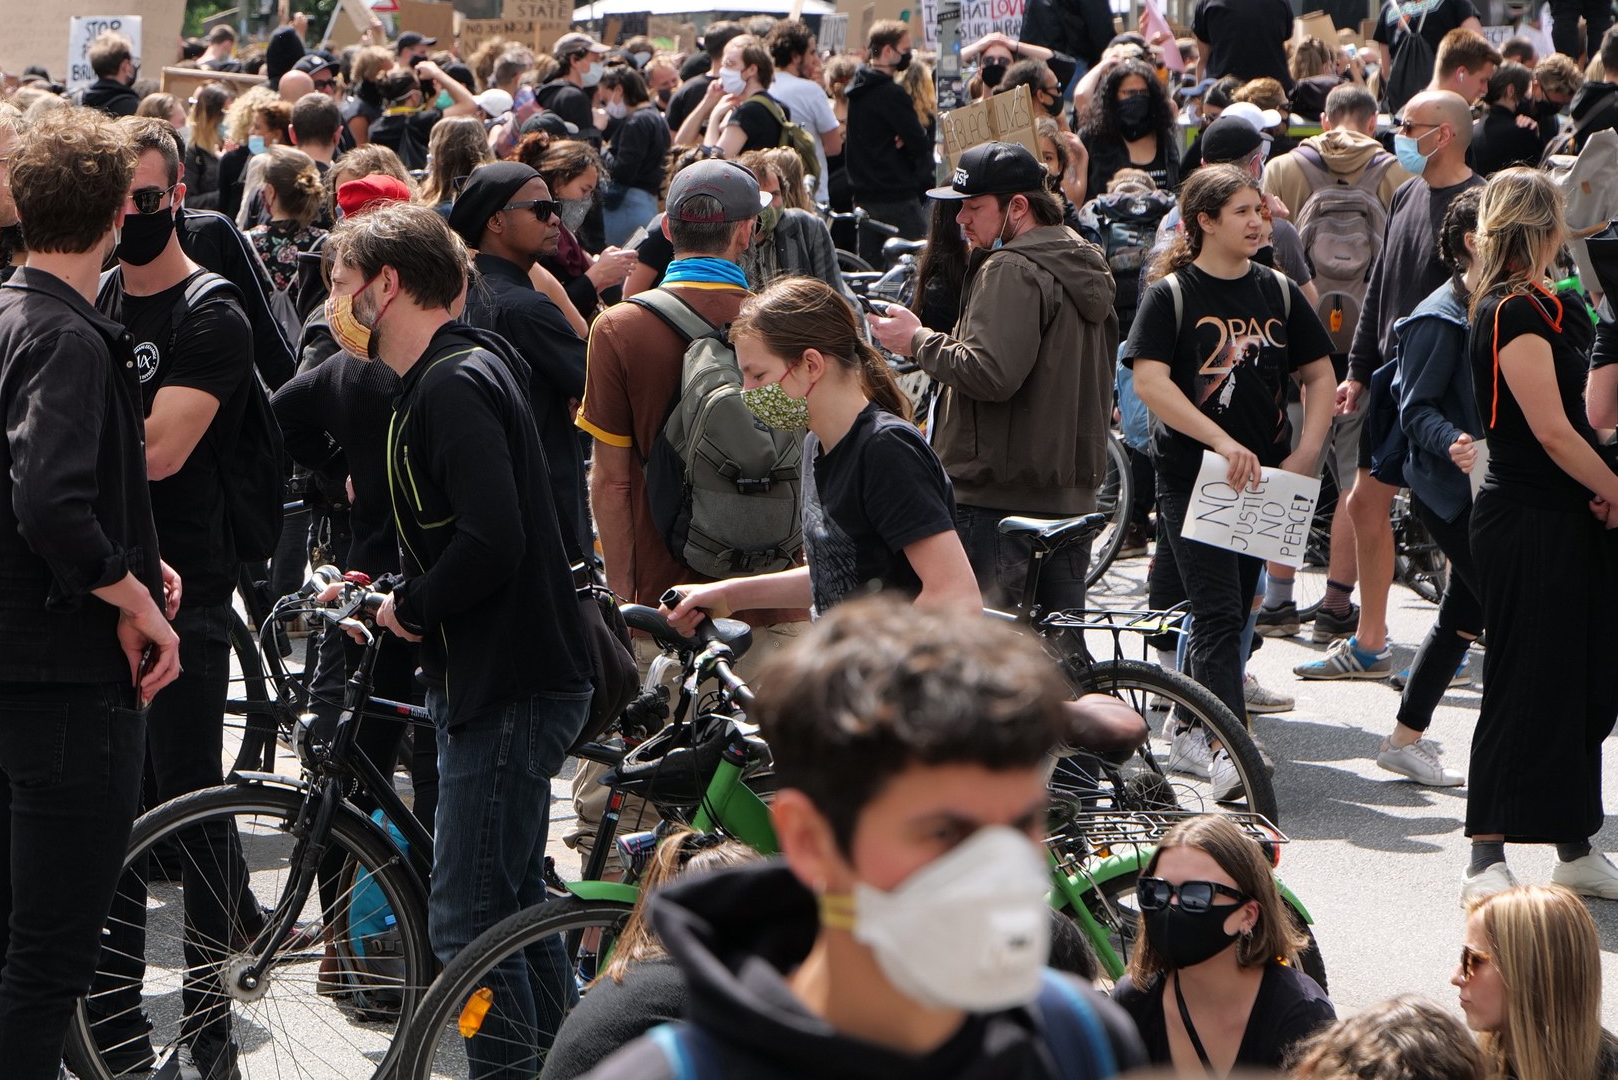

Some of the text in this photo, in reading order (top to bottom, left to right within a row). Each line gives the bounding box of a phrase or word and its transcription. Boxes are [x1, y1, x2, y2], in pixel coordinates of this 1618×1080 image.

[517, 4, 567, 18] STATE
[1195, 315, 1286, 376] 2PAC
[1195, 481, 1240, 529] NO
[1257, 501, 1286, 540] NO
[1279, 493, 1315, 558] PEACE!
